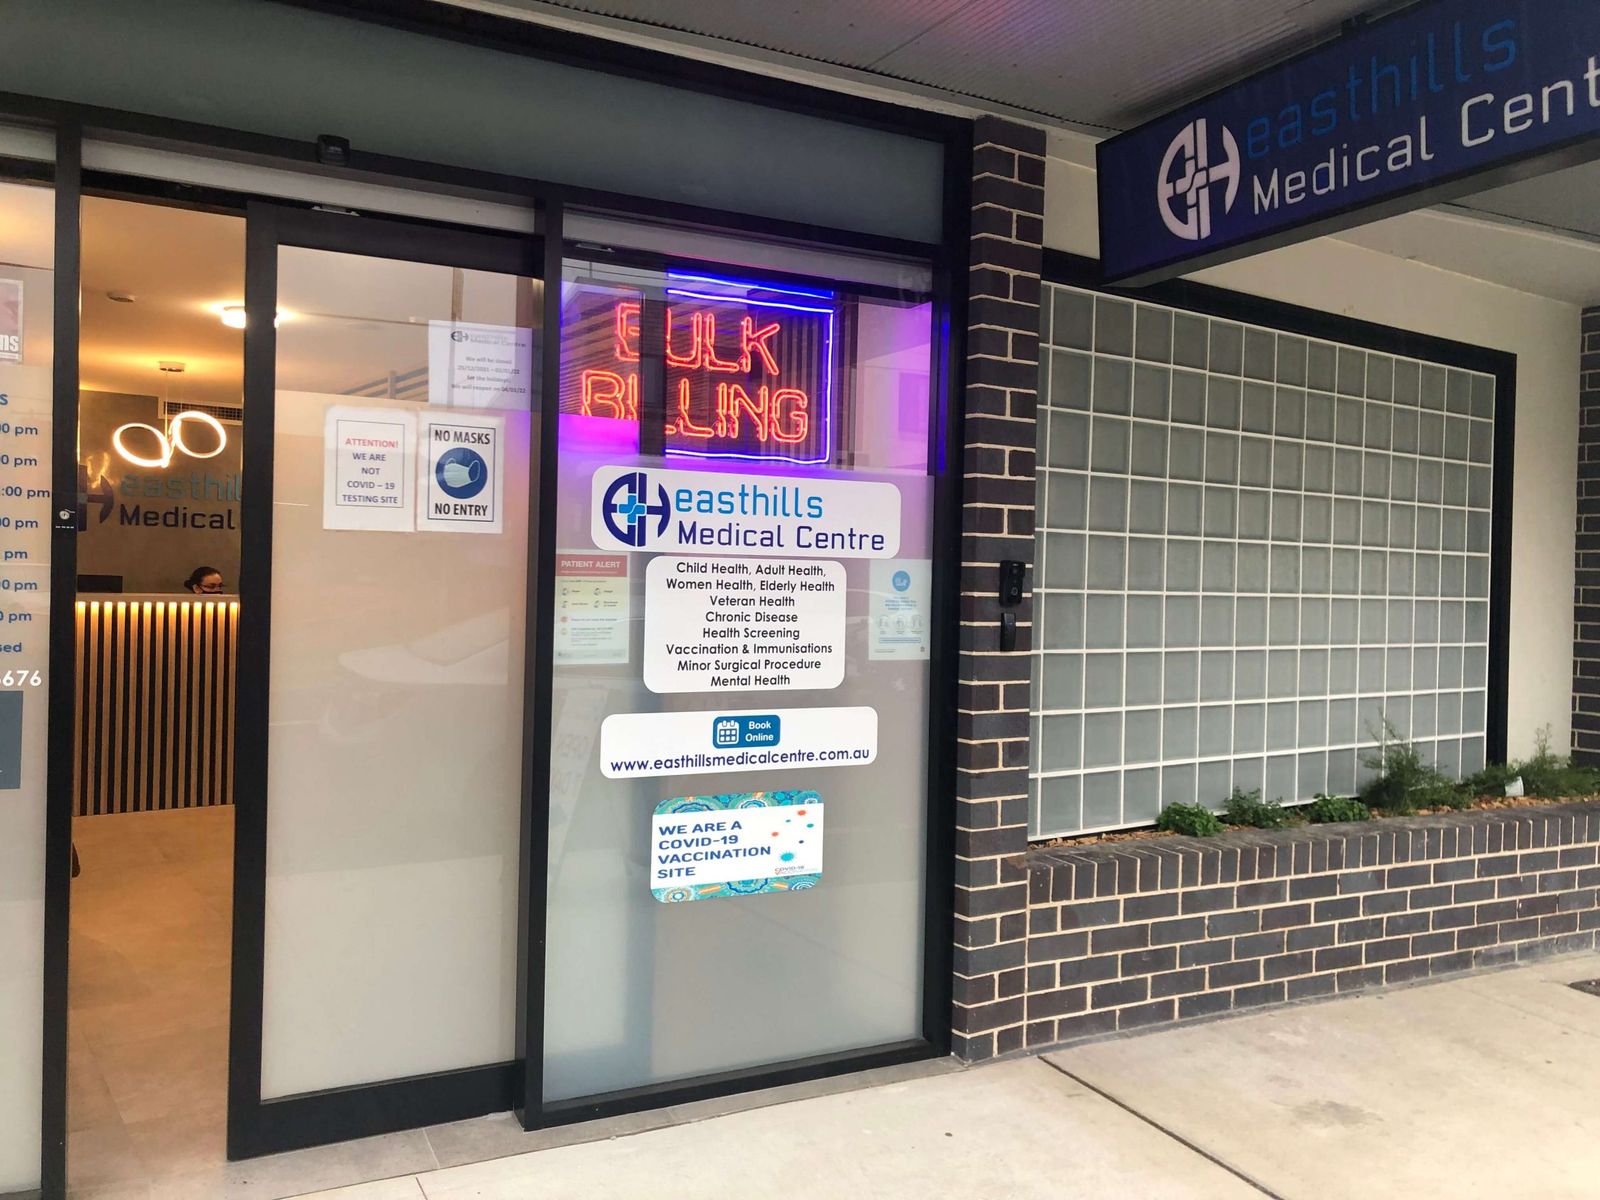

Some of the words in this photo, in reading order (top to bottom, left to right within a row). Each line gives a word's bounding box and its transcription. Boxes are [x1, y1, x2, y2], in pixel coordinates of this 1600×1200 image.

[1247, 18, 1517, 161] easthills
[1252, 114, 1435, 216] Medical
[581, 369, 809, 444] BILING
[15, 425, 38, 437] pm
[434, 429, 451, 442] NO
[453, 431, 491, 445] MASKS
[345, 437, 399, 449] ATTENTION!
[14, 456, 37, 468] pm
[352, 452, 367, 461] WE
[369, 452, 386, 462] ARE
[361, 467, 380, 476] NOT
[347, 480, 375, 490] COVID
[385, 482, 395, 491] 19
[27, 487, 51, 500] pm
[342, 494, 379, 504] TESTING
[380, 495, 398, 504] SITE
[674, 484, 824, 519] easthills
[120, 503, 236, 530] Medical
[434, 503, 451, 515] NO
[453, 503, 488, 517] ENTRY
[15, 519, 38, 531] pm
[678, 520, 785, 548] Medical
[796, 525, 885, 551] Centre
[4, 549, 28, 561] pm
[561, 560, 594, 569] PATIENT
[595, 561, 621, 569] ALERT
[676, 562, 708, 574] Child
[711, 563, 752, 576] Health,
[755, 564, 785, 576] Adult
[788, 565, 827, 578] Health,
[14, 580, 38, 593] pm
[666, 578, 712, 590] Women
[716, 579, 757, 592] Health,
[760, 580, 797, 594] Elderly
[800, 581, 835, 592] Health
[710, 595, 756, 607] Veteran
[759, 596, 795, 607] Health
[8, 611, 32, 624] pm
[705, 611, 751, 623] Chronic
[754, 611, 798, 623] Disease
[702, 627, 740, 639] Health
[743, 627, 800, 641] Screening
[666, 643, 739, 655] Vaccination
[742, 644, 750, 655] &
[753, 643, 833, 654] Immunisations
[677, 660, 711, 672] Minor
[714, 659, 761, 673] Surgical
[764, 658, 822, 670] Procedure
[710, 675, 751, 687] Mental
[754, 674, 791, 686] Health
[748, 720, 772, 731] Book
[745, 732, 774, 743] Online
[610, 747, 870, 772] www.easthillsmedicalcentre.com.au
[658, 824, 688, 836] WE
[691, 821, 727, 834] ARE
[730, 820, 743, 832] A
[658, 834, 739, 851] COVID-19
[657, 846, 771, 865] VACCINATION
[657, 866, 697, 879] SITE
